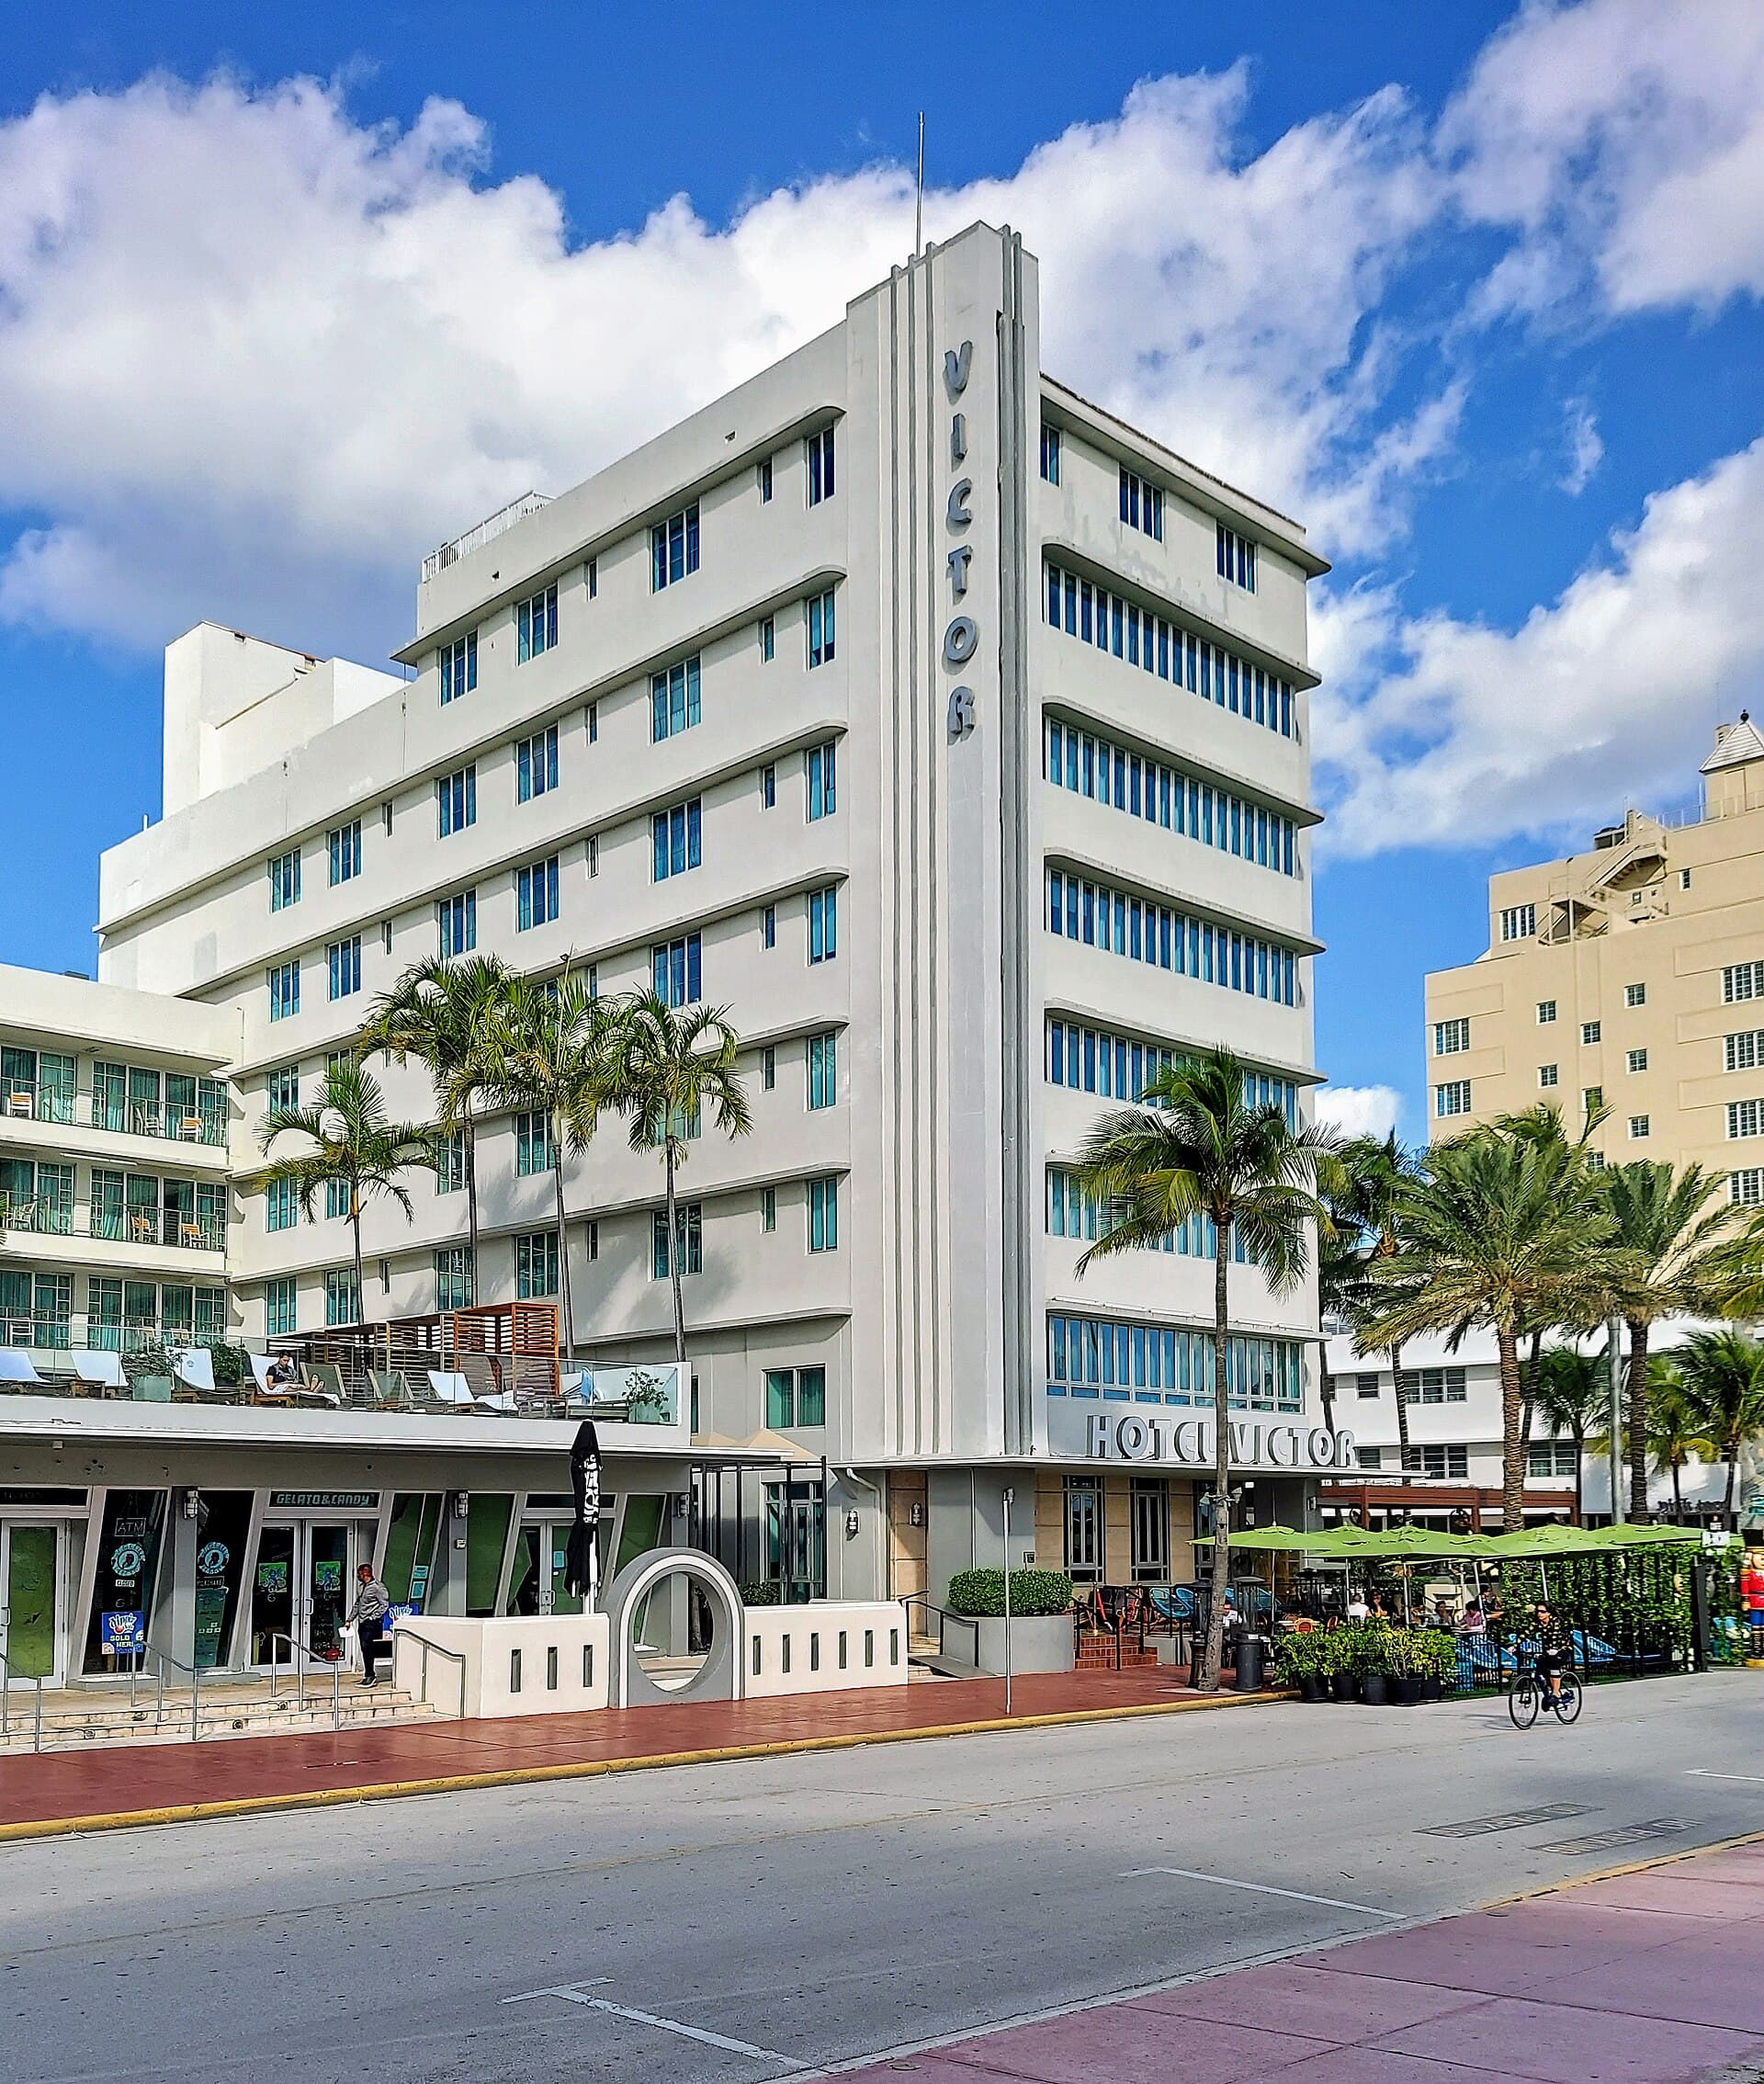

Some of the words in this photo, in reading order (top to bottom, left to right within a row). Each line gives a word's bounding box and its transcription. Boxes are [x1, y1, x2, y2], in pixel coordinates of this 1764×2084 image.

[944, 340, 978, 738] VICTOR
[1087, 1415, 1217, 1461] HOTEL
[1227, 1422, 1355, 1467] VICTOR
[117, 1521, 144, 1534] ATM
